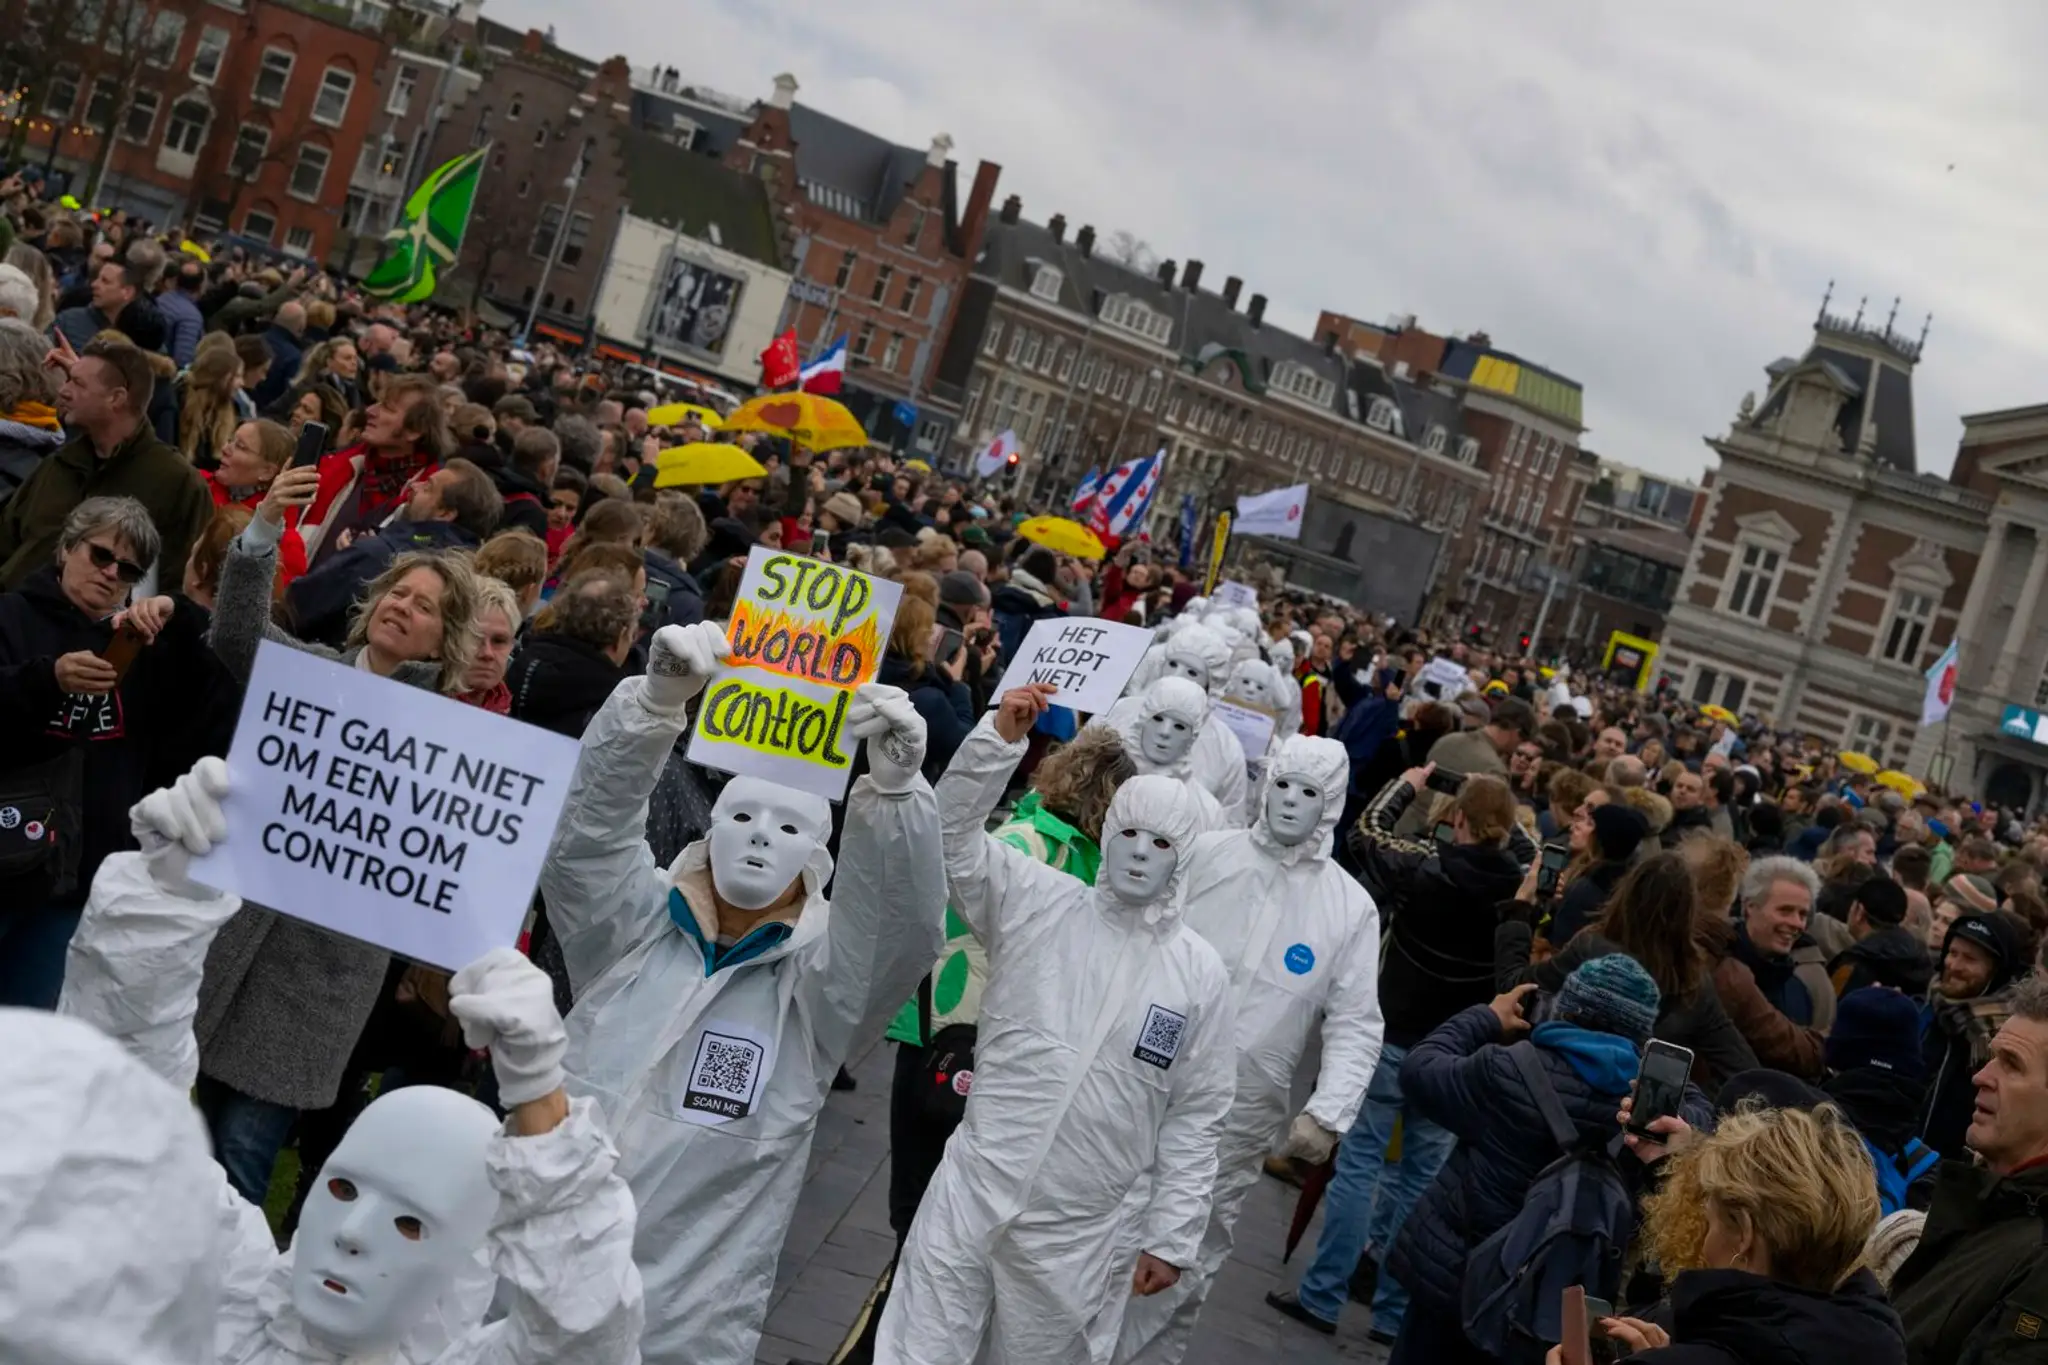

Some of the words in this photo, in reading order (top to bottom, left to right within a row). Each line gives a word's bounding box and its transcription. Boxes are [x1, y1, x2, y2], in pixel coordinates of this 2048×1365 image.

[757, 555, 869, 636] STOP
[732, 619, 862, 684] WORLD
[1032, 646, 1110, 671] KLOPT
[1058, 626, 1108, 646] HET
[1026, 667, 1087, 692] NIET!
[263, 691, 335, 739] HET
[340, 718, 448, 775] GAAT
[451, 752, 544, 807] NIET
[257, 734, 320, 780] OM
[325, 756, 400, 806] EEN
[410, 780, 523, 845] VIRUS
[281, 784, 392, 849] MAAR
[399, 825, 469, 873] OM
[261, 822, 459, 914] CONTROLE
[692, 1095, 722, 1110] SCAN
[722, 1102, 741, 1115] ME
